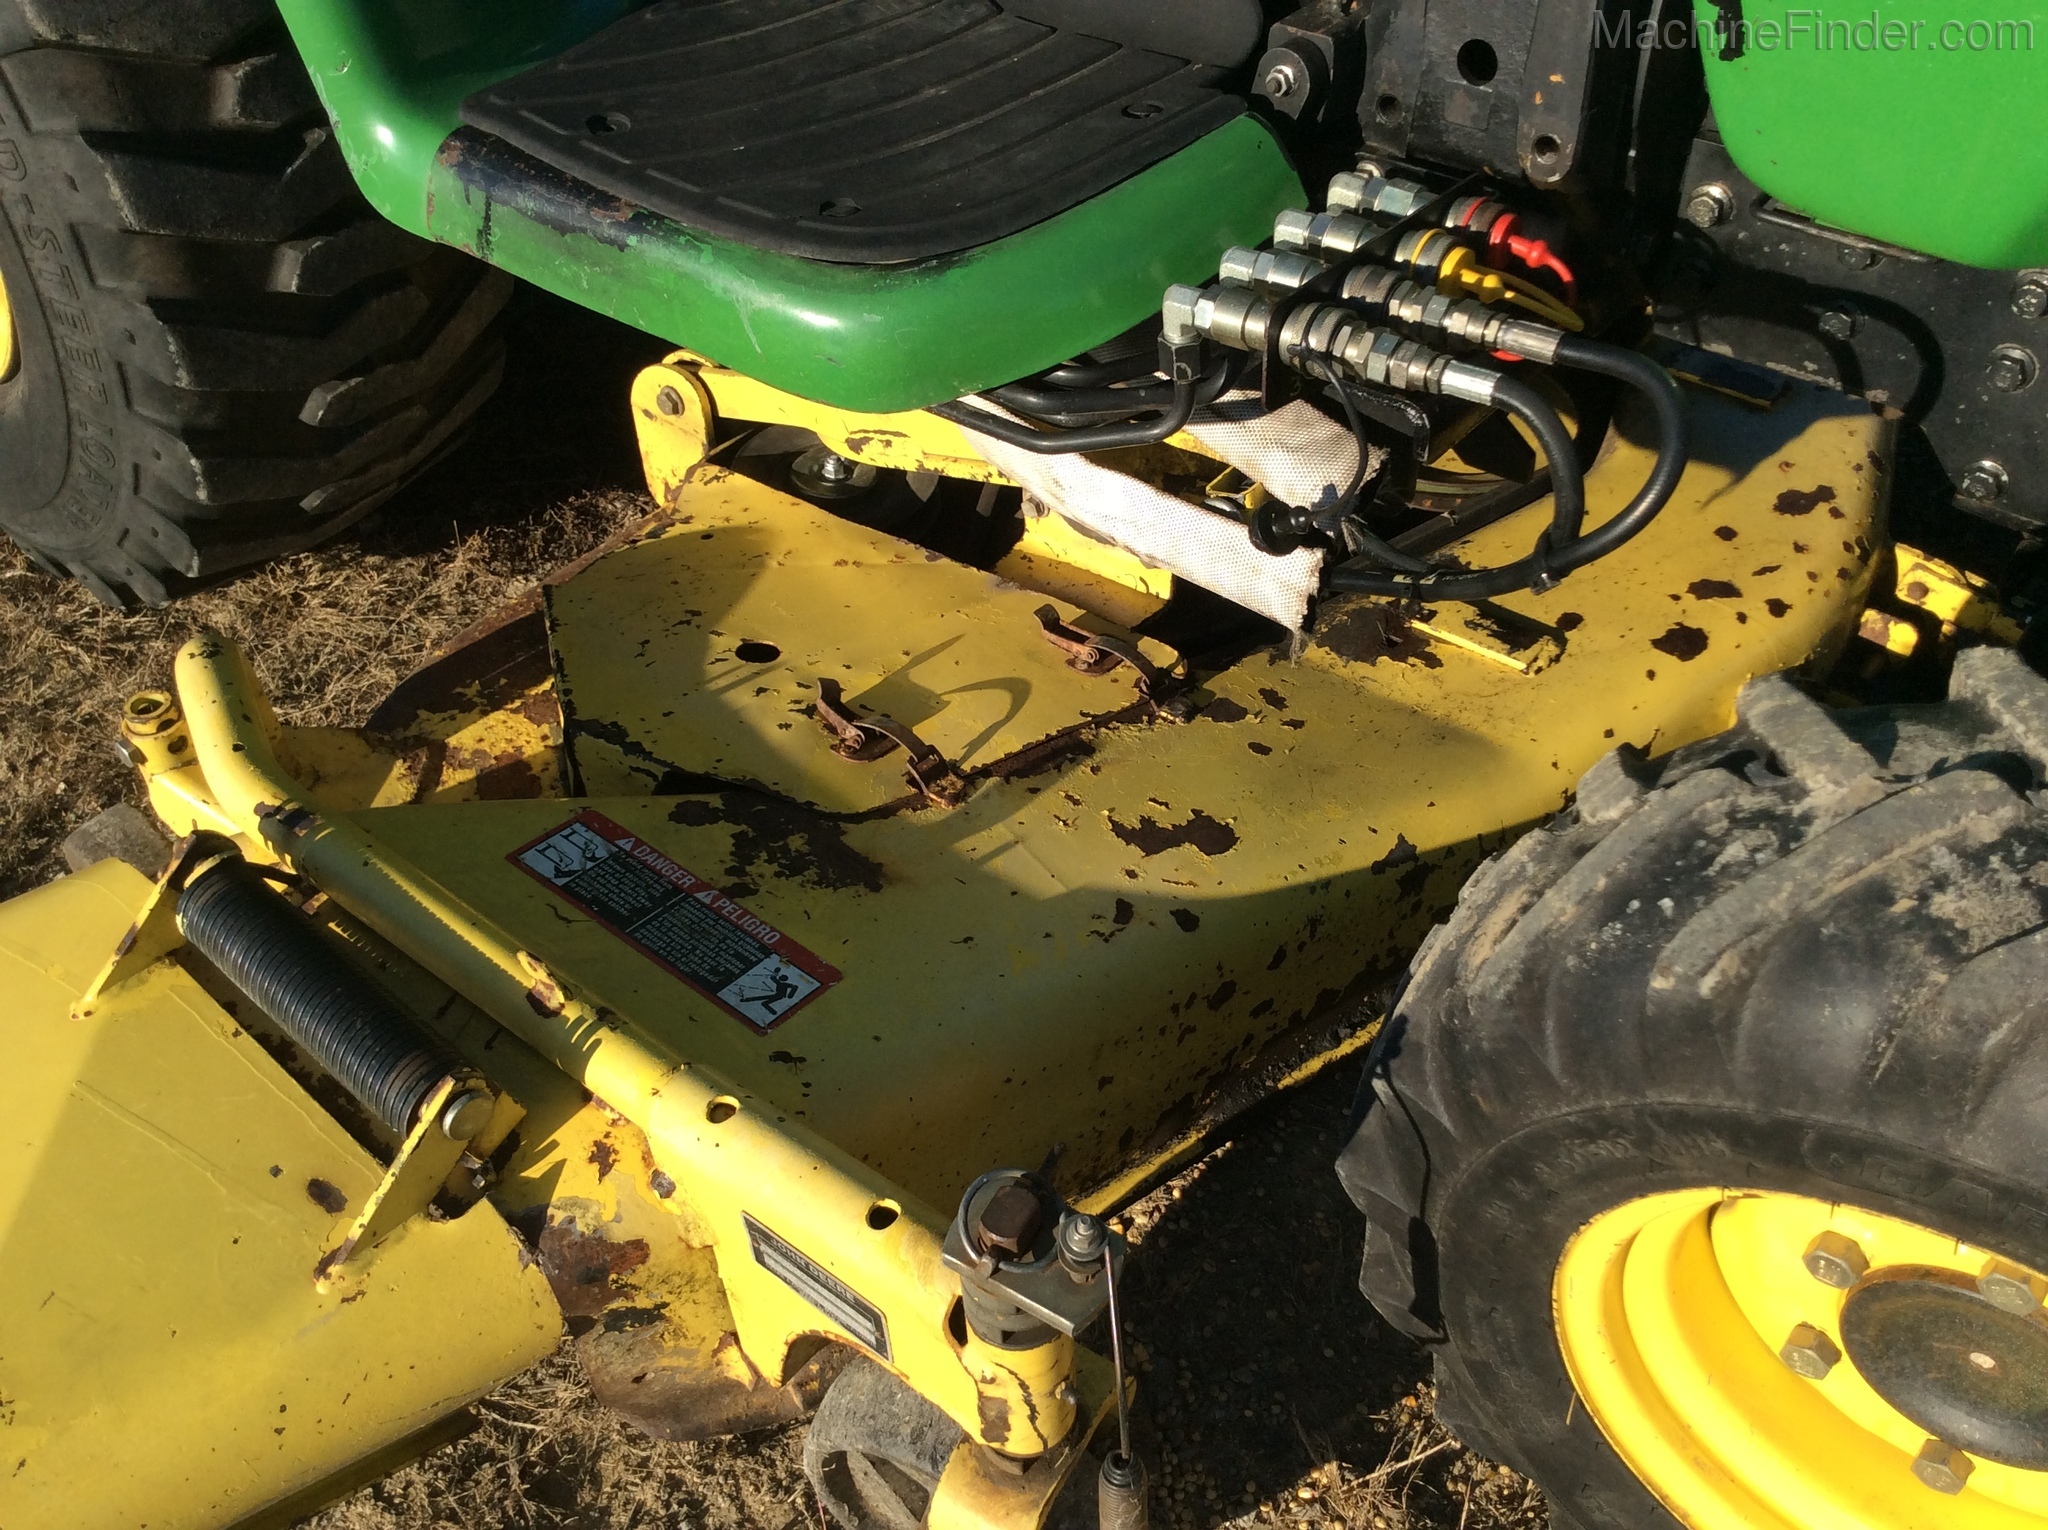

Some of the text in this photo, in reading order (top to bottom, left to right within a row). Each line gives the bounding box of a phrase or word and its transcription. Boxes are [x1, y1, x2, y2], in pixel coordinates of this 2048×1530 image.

[0, 114, 108, 405] D-STEER
[632, 845, 696, 888] DANGER
[712, 898, 782, 946] PELIGRO
[770, 1238, 856, 1303] JOHN DEERE
